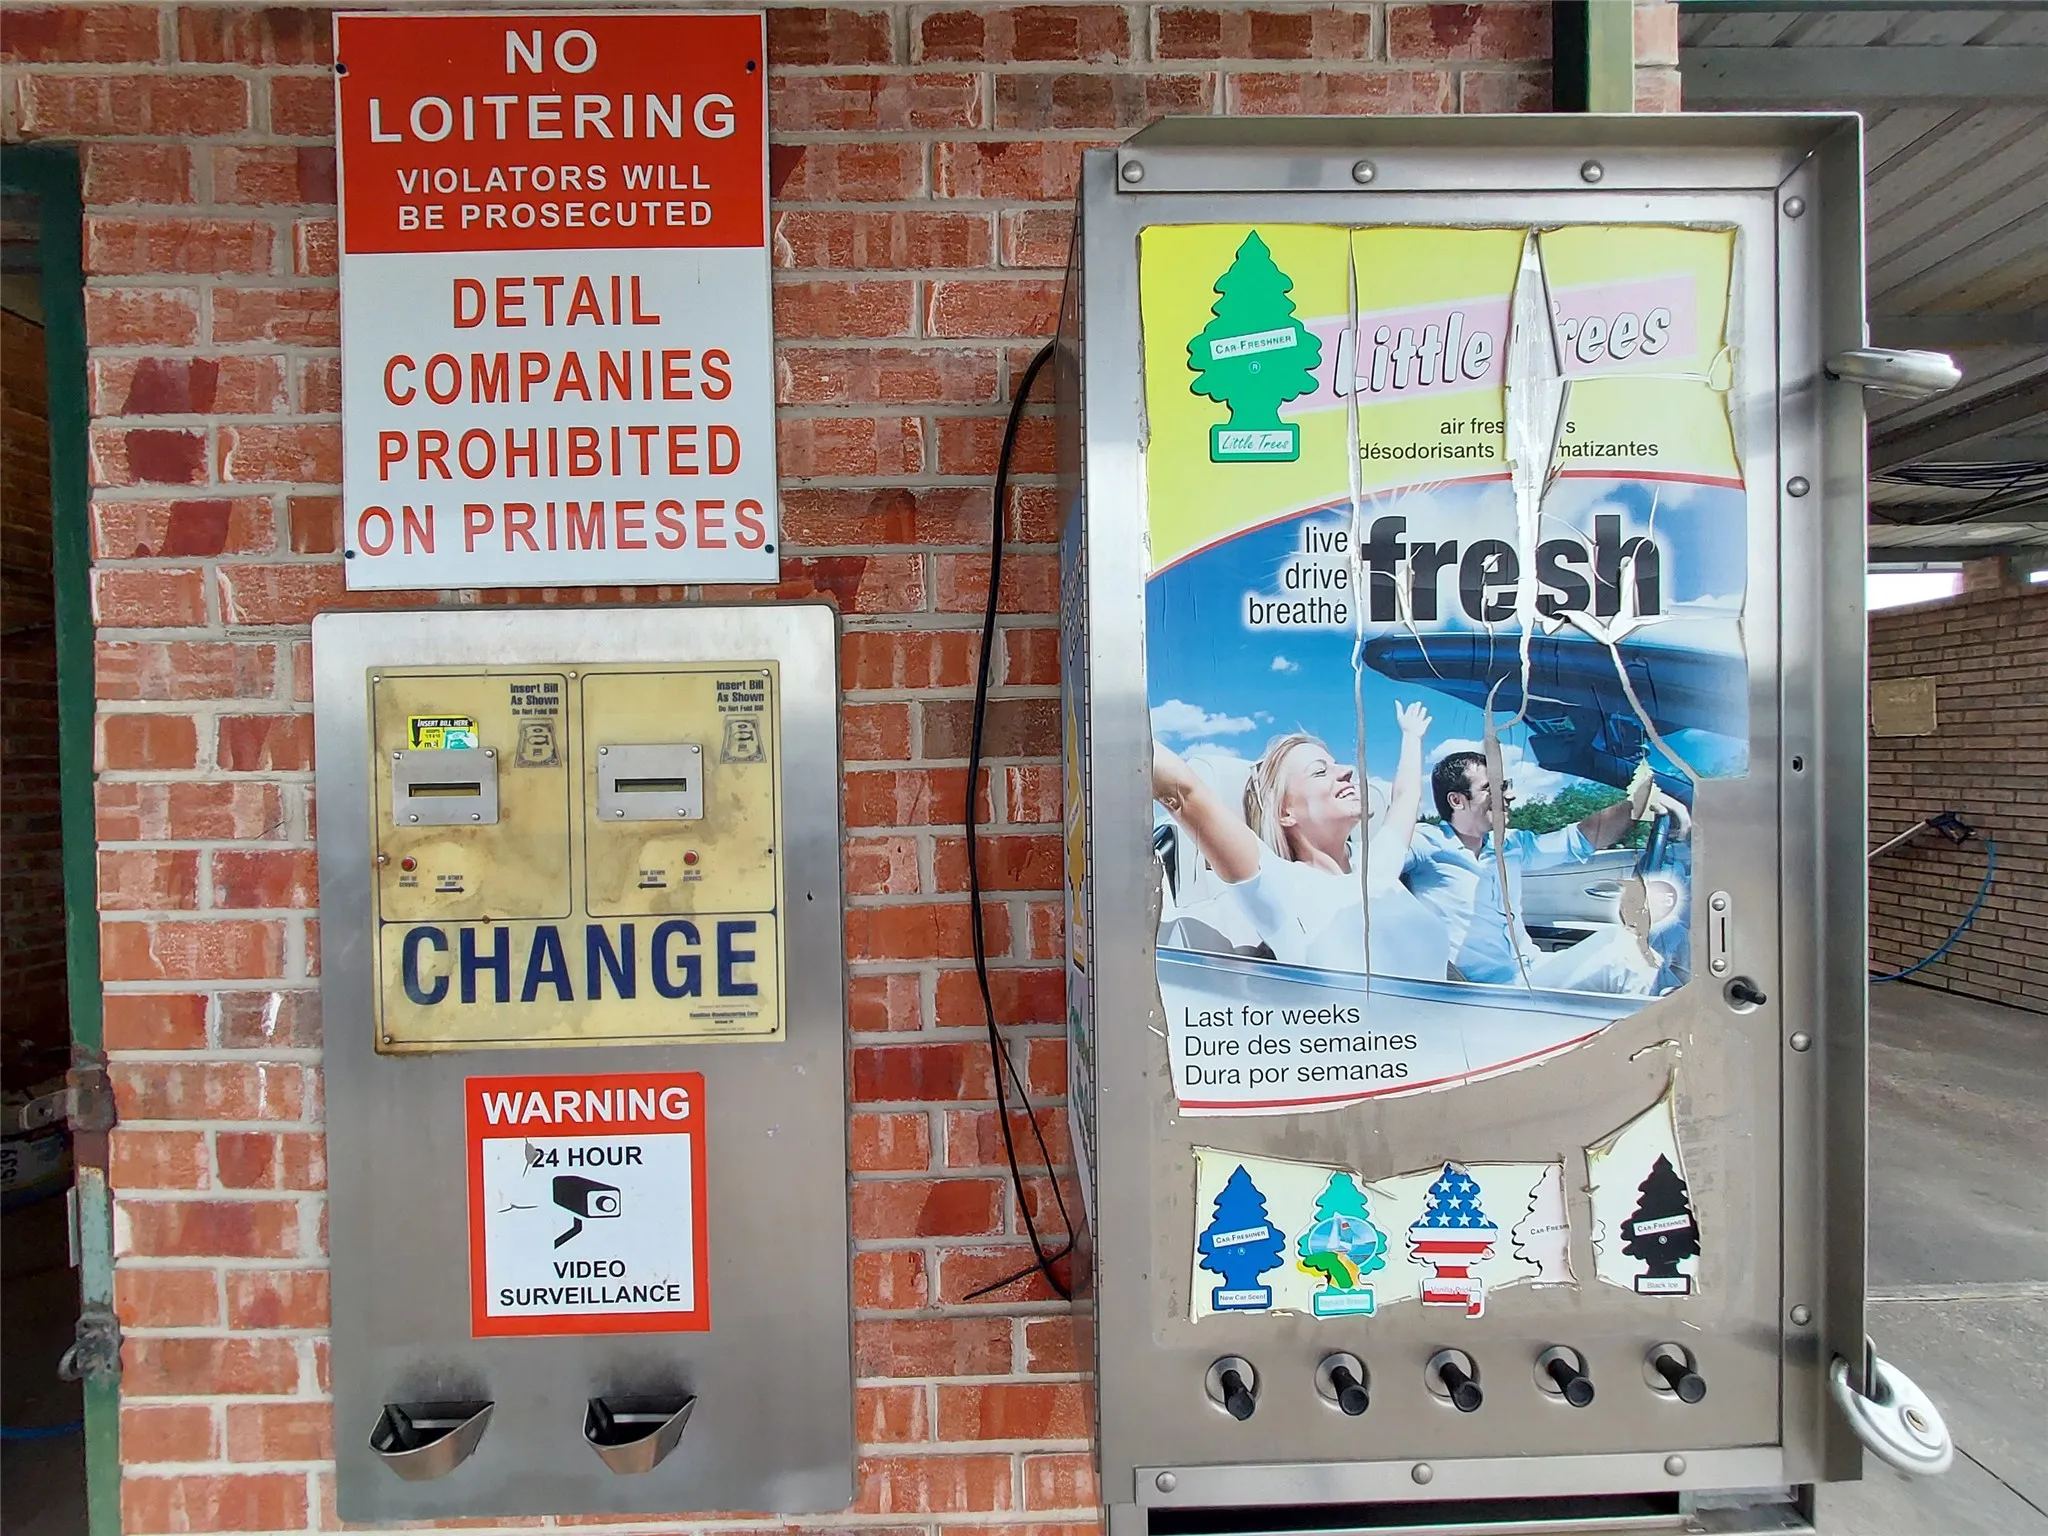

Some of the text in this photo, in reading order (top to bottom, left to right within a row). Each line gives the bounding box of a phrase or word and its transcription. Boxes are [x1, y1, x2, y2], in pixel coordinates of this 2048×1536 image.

[506, 30, 597, 74] NO
[370, 93, 736, 143] LOITERING
[397, 164, 711, 195] VIOLATORS WILL
[399, 201, 713, 230] BE PROSECUTED
[452, 275, 661, 329] DETAIL
[1215, 334, 1292, 355] CAR-FRESHNER
[1333, 300, 1672, 398] Little rees
[383, 348, 733, 406] COMPANIES
[1440, 417, 1465, 435] air
[378, 425, 742, 482] PROHIBITED
[1221, 433, 1290, 451] Little Trees
[1359, 442, 1495, 460] désodorisants
[356, 498, 766, 556] ON PRIMESES
[1305, 526, 1348, 553] live
[1285, 562, 1348, 590] drive
[1361, 513, 1661, 623] fresh
[1249, 596, 1348, 625] breathe
[510, 682, 559, 694] Insert Bill
[716, 679, 764, 691] Insert Bill
[717, 691, 764, 703] As Shown
[511, 695, 559, 706] As Shown
[402, 920, 759, 1005] CHANGE
[1185, 1003, 1361, 1028] Last for weeks
[1185, 1030, 1418, 1057] Dure des semaines
[1185, 1061, 1409, 1088] Dura por semanas
[482, 1087, 690, 1125] WARNING
[531, 1145, 644, 1168] 24 HOUR
[553, 1259, 627, 1279] VIDEO
[499, 1284, 682, 1306] SURVEILLANCE
